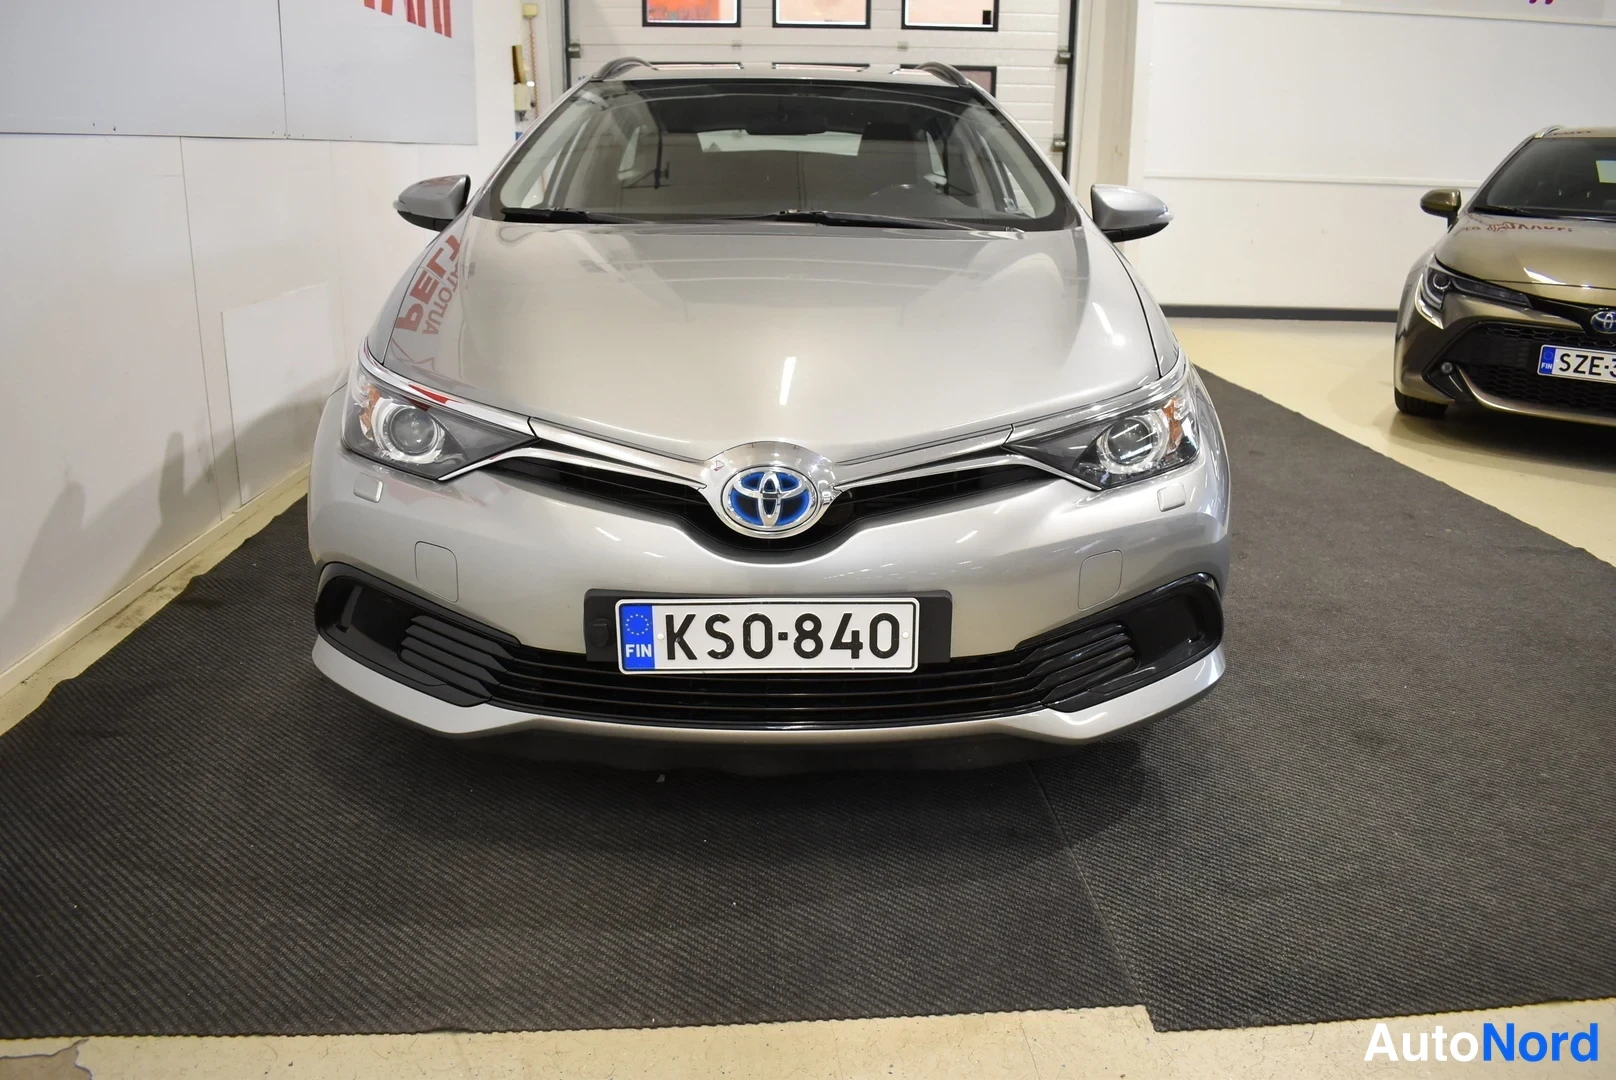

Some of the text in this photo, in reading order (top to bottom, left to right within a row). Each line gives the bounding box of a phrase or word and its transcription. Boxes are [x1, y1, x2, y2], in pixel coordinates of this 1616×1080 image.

[1541, 362, 1553, 370] FIN
[664, 612, 901, 661] KSO-840
[625, 643, 653, 659] FIN
